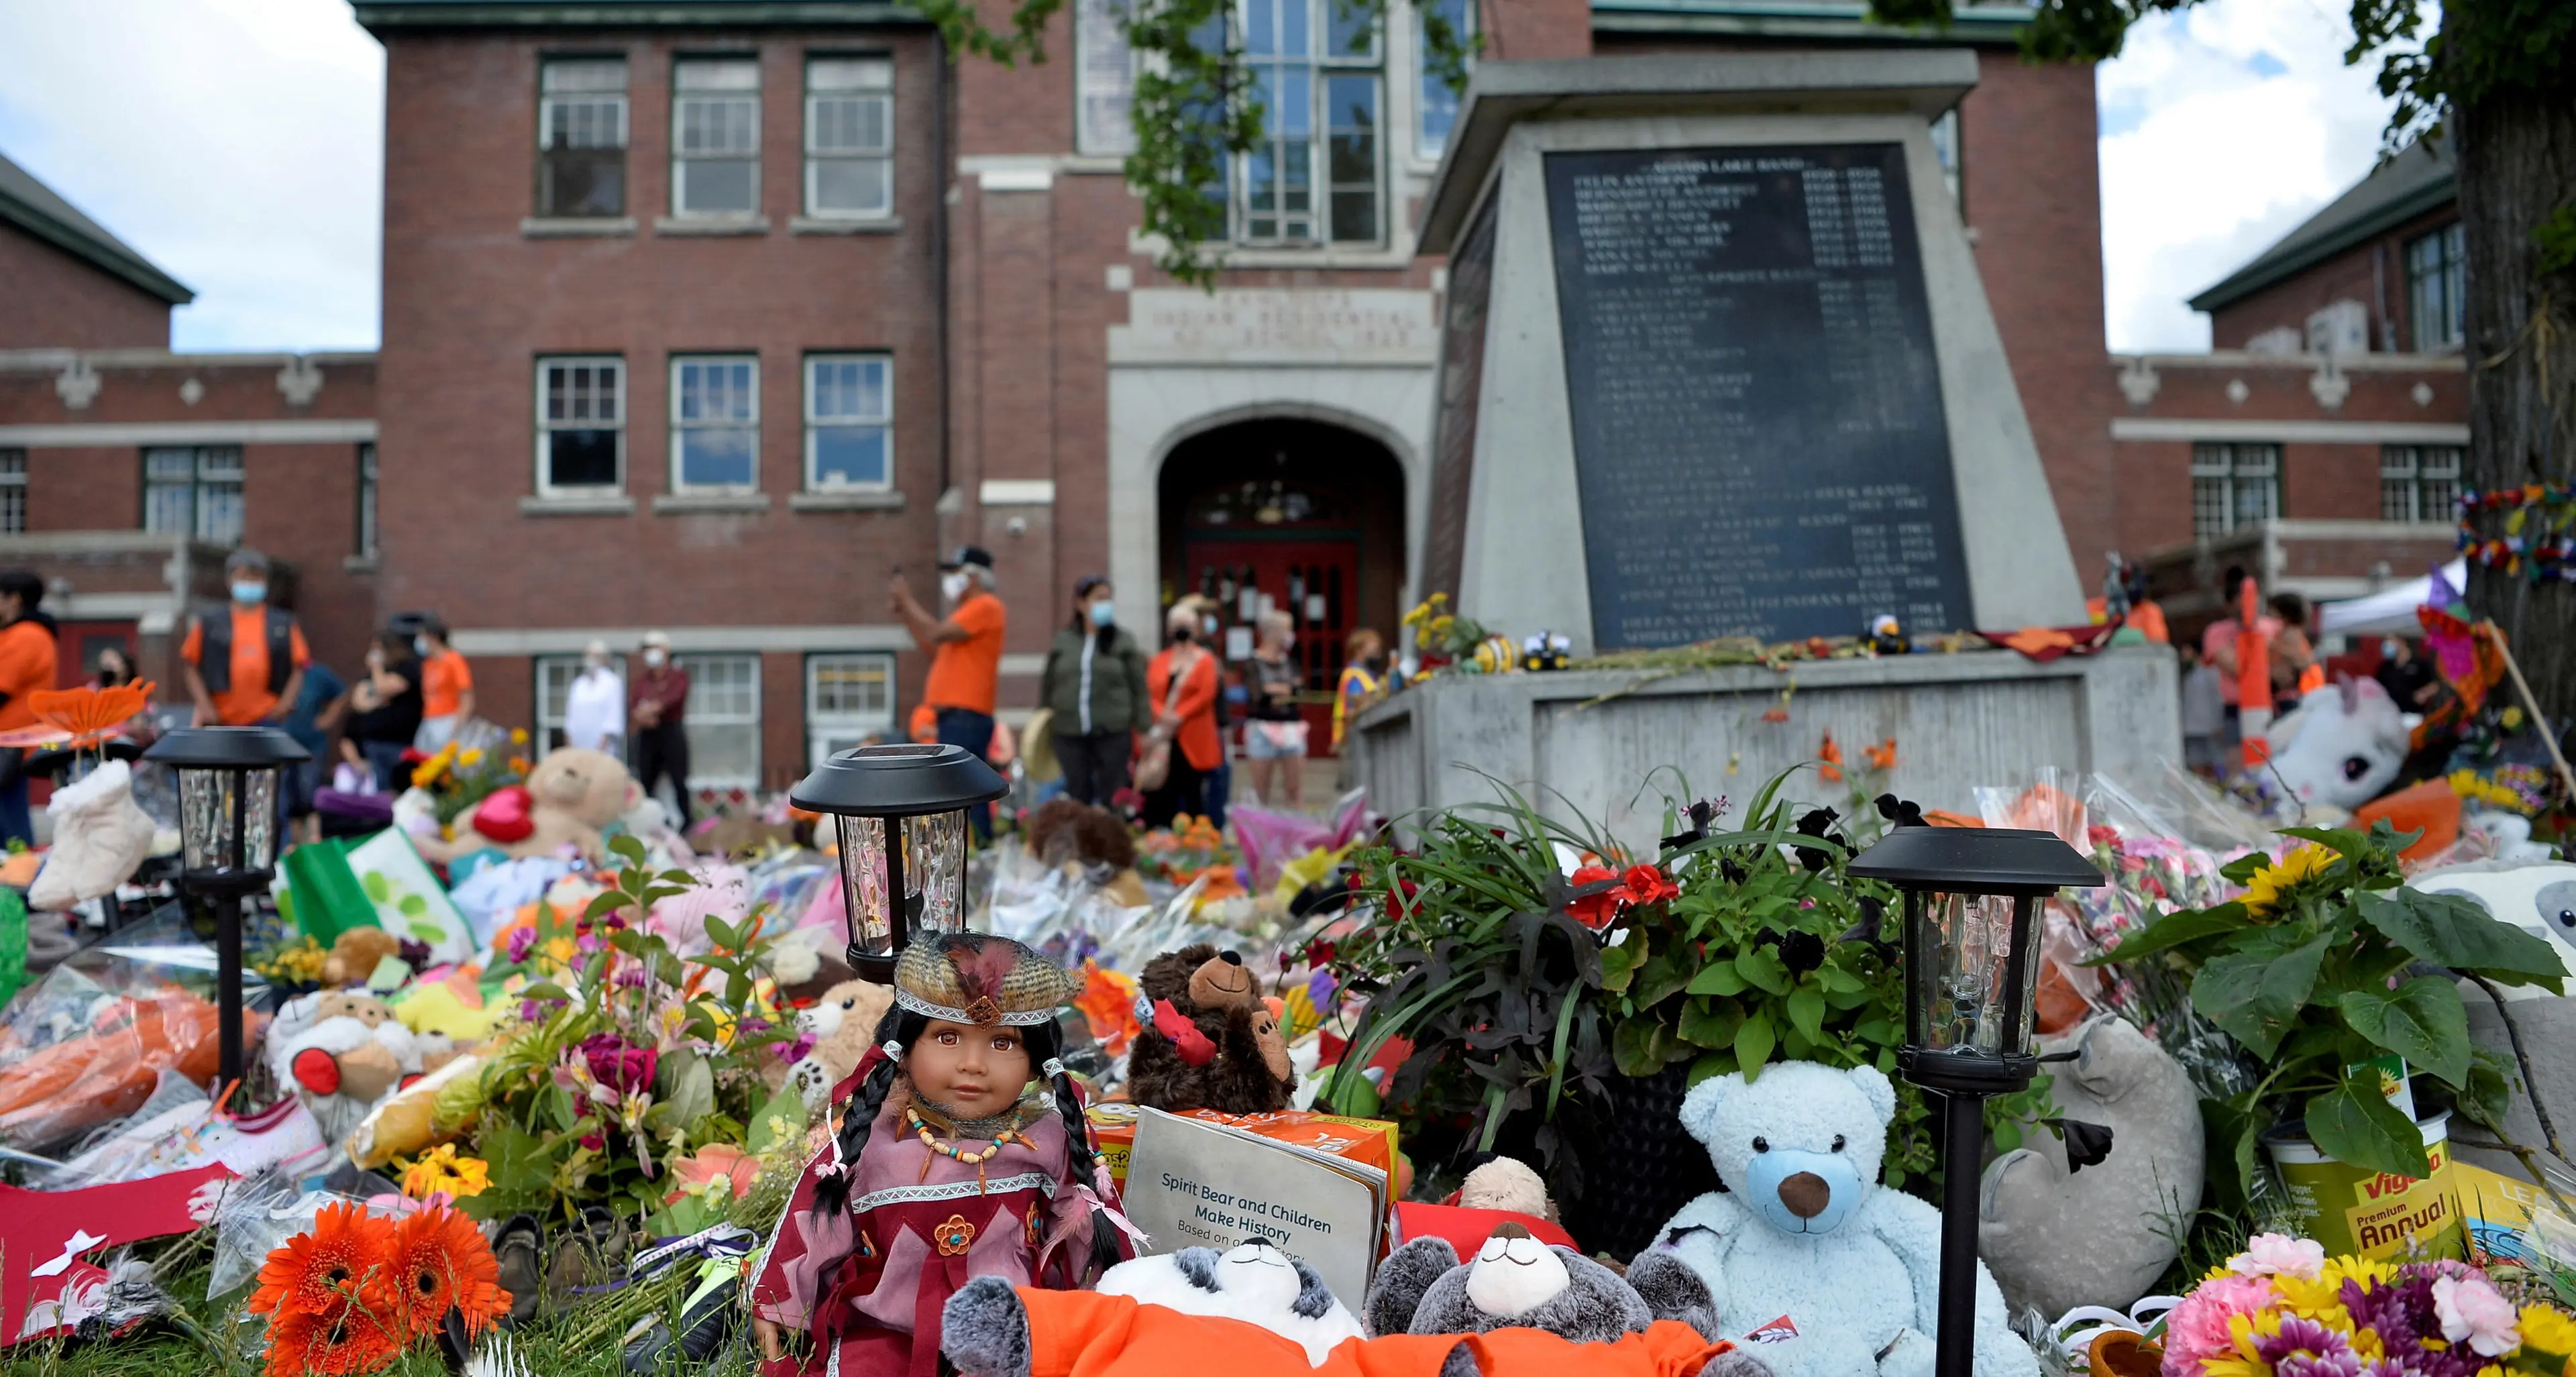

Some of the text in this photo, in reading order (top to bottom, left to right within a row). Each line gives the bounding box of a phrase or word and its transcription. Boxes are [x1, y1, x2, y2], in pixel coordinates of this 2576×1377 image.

[1711, 160, 1755, 172] LAKE
[2363, 1152, 2443, 1200] Vigo
[1161, 1172, 1332, 1234] Spirit Bear and Children
[2357, 1203, 2407, 1227] Premium
[2360, 1193, 2447, 1250] Annual
[1177, 1219, 1211, 1240] Based
[1214, 1234, 1229, 1246] on
[1195, 1205, 1291, 1246] Make History
